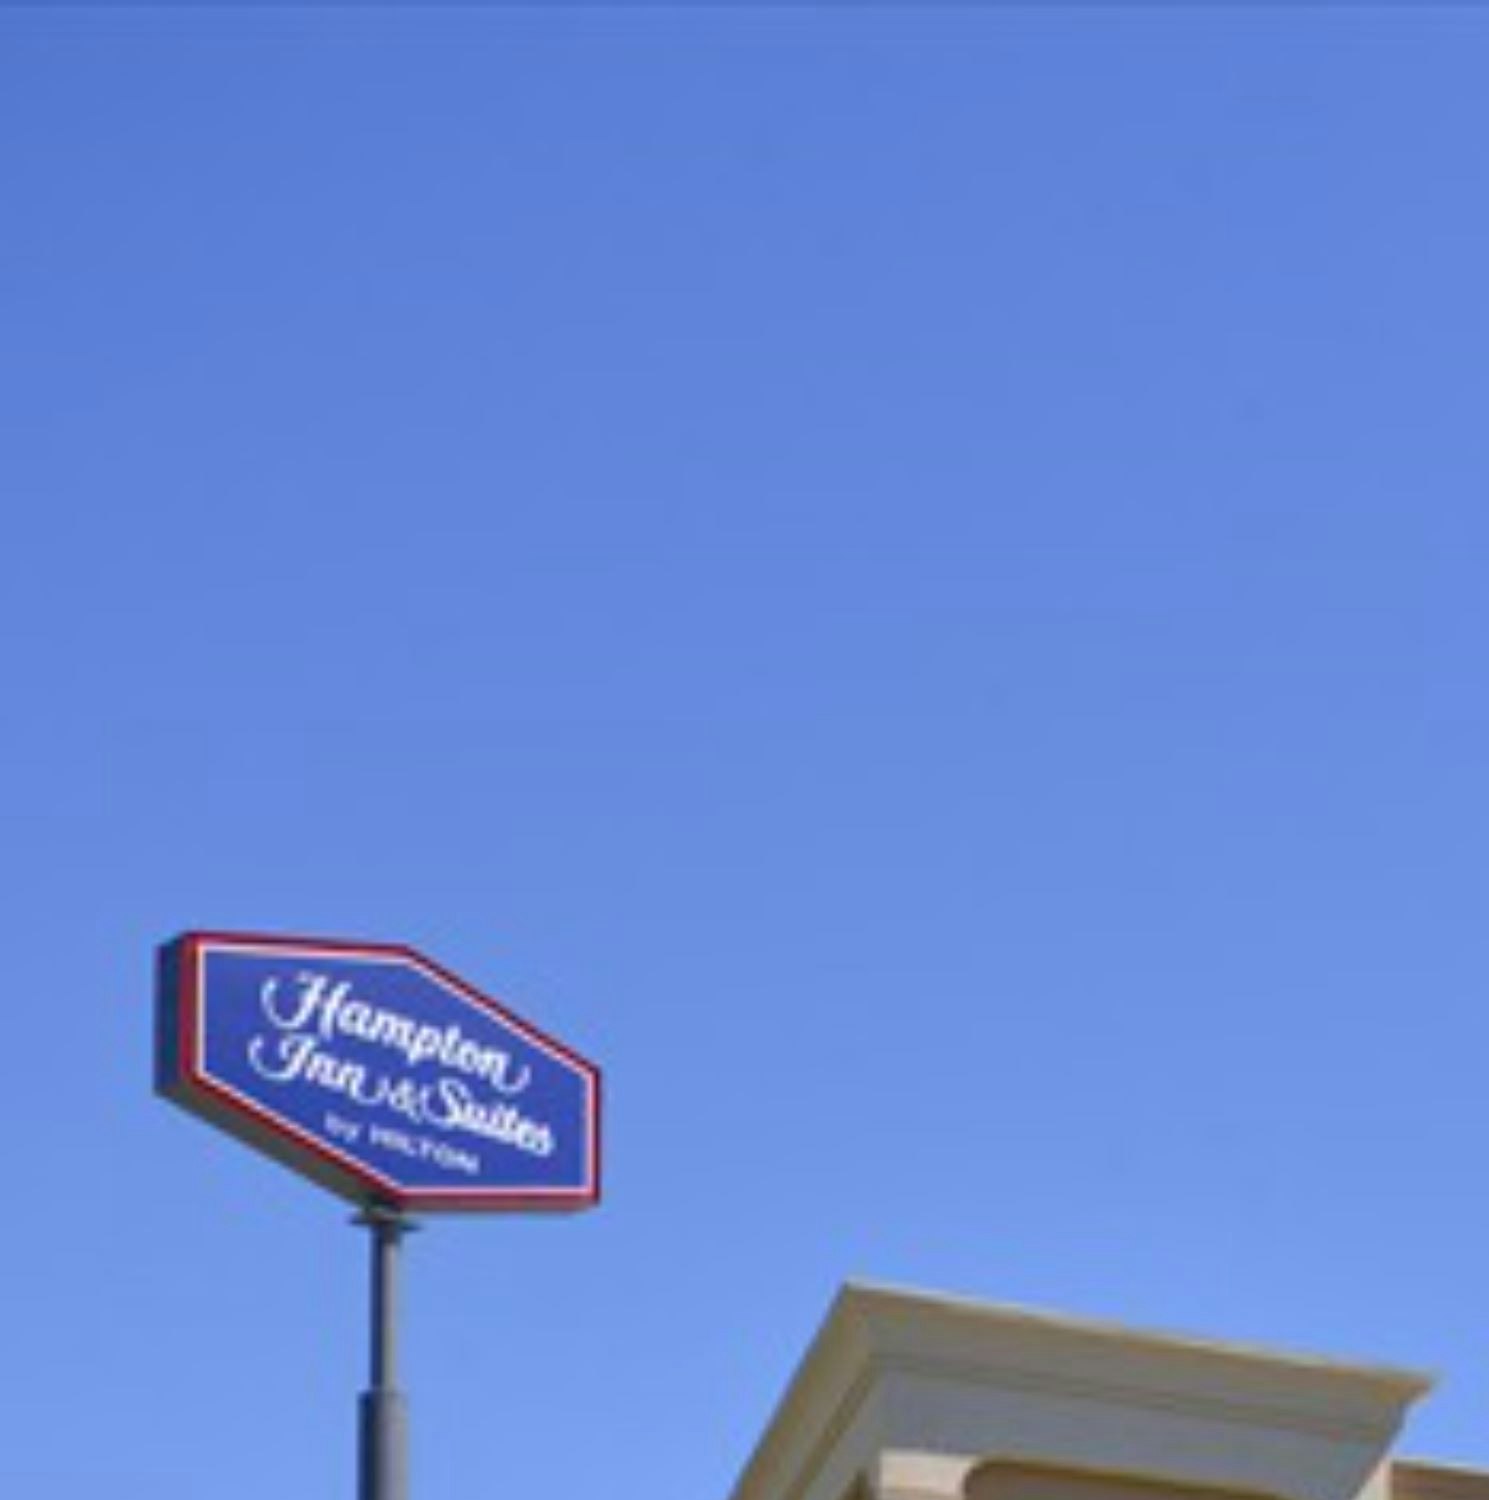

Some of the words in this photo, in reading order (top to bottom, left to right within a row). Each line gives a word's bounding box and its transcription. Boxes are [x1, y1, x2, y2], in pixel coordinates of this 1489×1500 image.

[260, 970, 531, 1094] Hampton
[246, 1032, 388, 1105] Inn
[387, 1079, 423, 1125] &
[418, 1076, 555, 1157] Suites
[368, 1122, 480, 1176] HILTON
